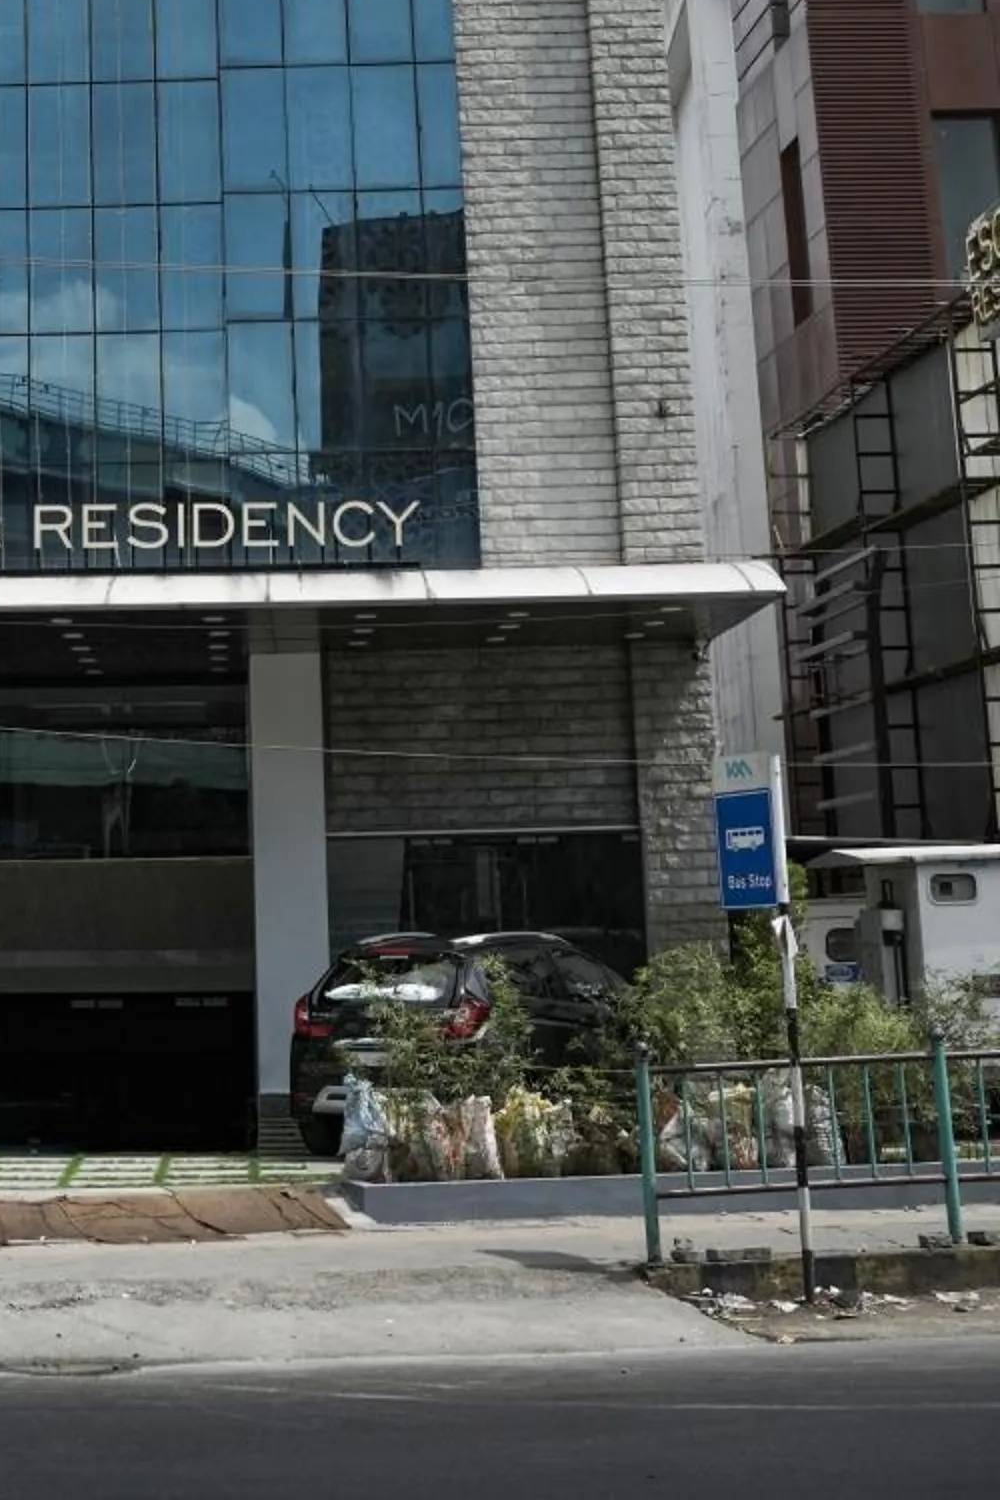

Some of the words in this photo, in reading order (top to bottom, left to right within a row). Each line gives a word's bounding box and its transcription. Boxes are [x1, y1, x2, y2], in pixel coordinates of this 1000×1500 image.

[33, 500, 421, 550] RESIDENCY
[728, 875, 746, 889] Bus
[749, 873, 771, 891] Stop
